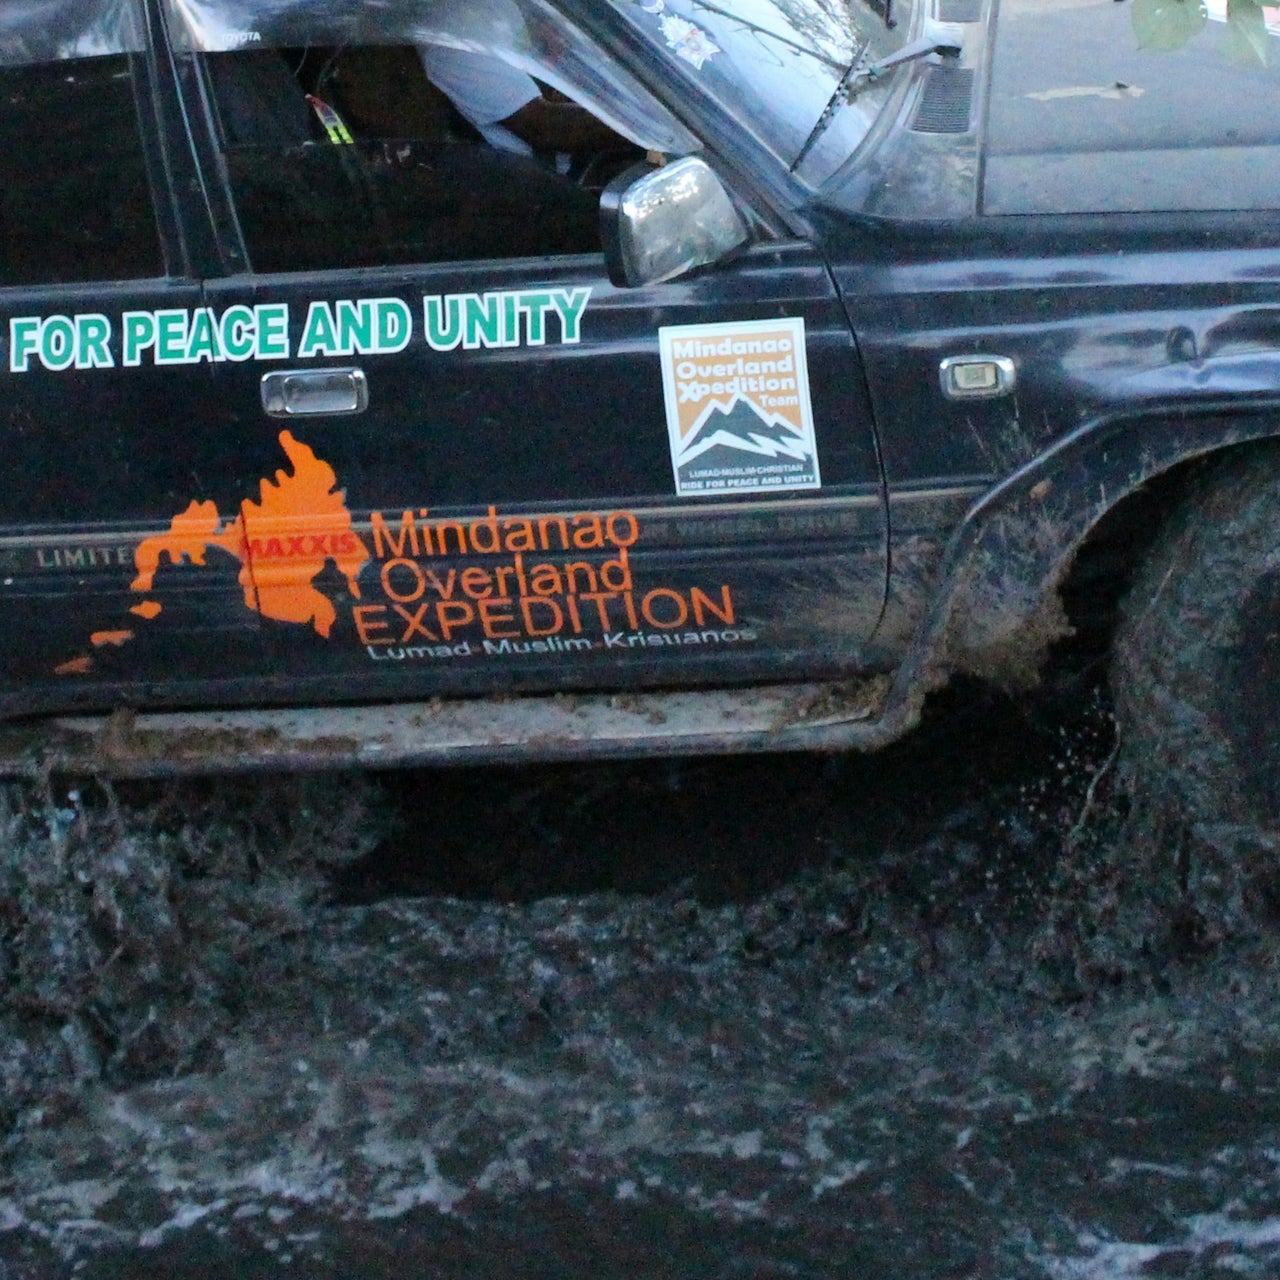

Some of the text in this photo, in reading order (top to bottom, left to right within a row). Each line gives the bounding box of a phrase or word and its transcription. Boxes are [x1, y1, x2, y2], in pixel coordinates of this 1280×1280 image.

[10, 314, 114, 373] FOR
[120, 302, 290, 369] PEACE
[297, 296, 413, 358] AND
[422, 286, 593, 350] UNITY
[673, 337, 793, 359] Mindanao
[676, 355, 794, 380] Overland
[678, 376, 796, 403] Xpedition
[758, 394, 799, 407] Team
[681, 474, 816, 490] RIDE FOR PEACE AND UNITY
[369, 506, 640, 560] Mindanao
[36, 545, 134, 569] LIMITE
[380, 548, 633, 604] Overland
[352, 586, 736, 646] EXPEDITION
